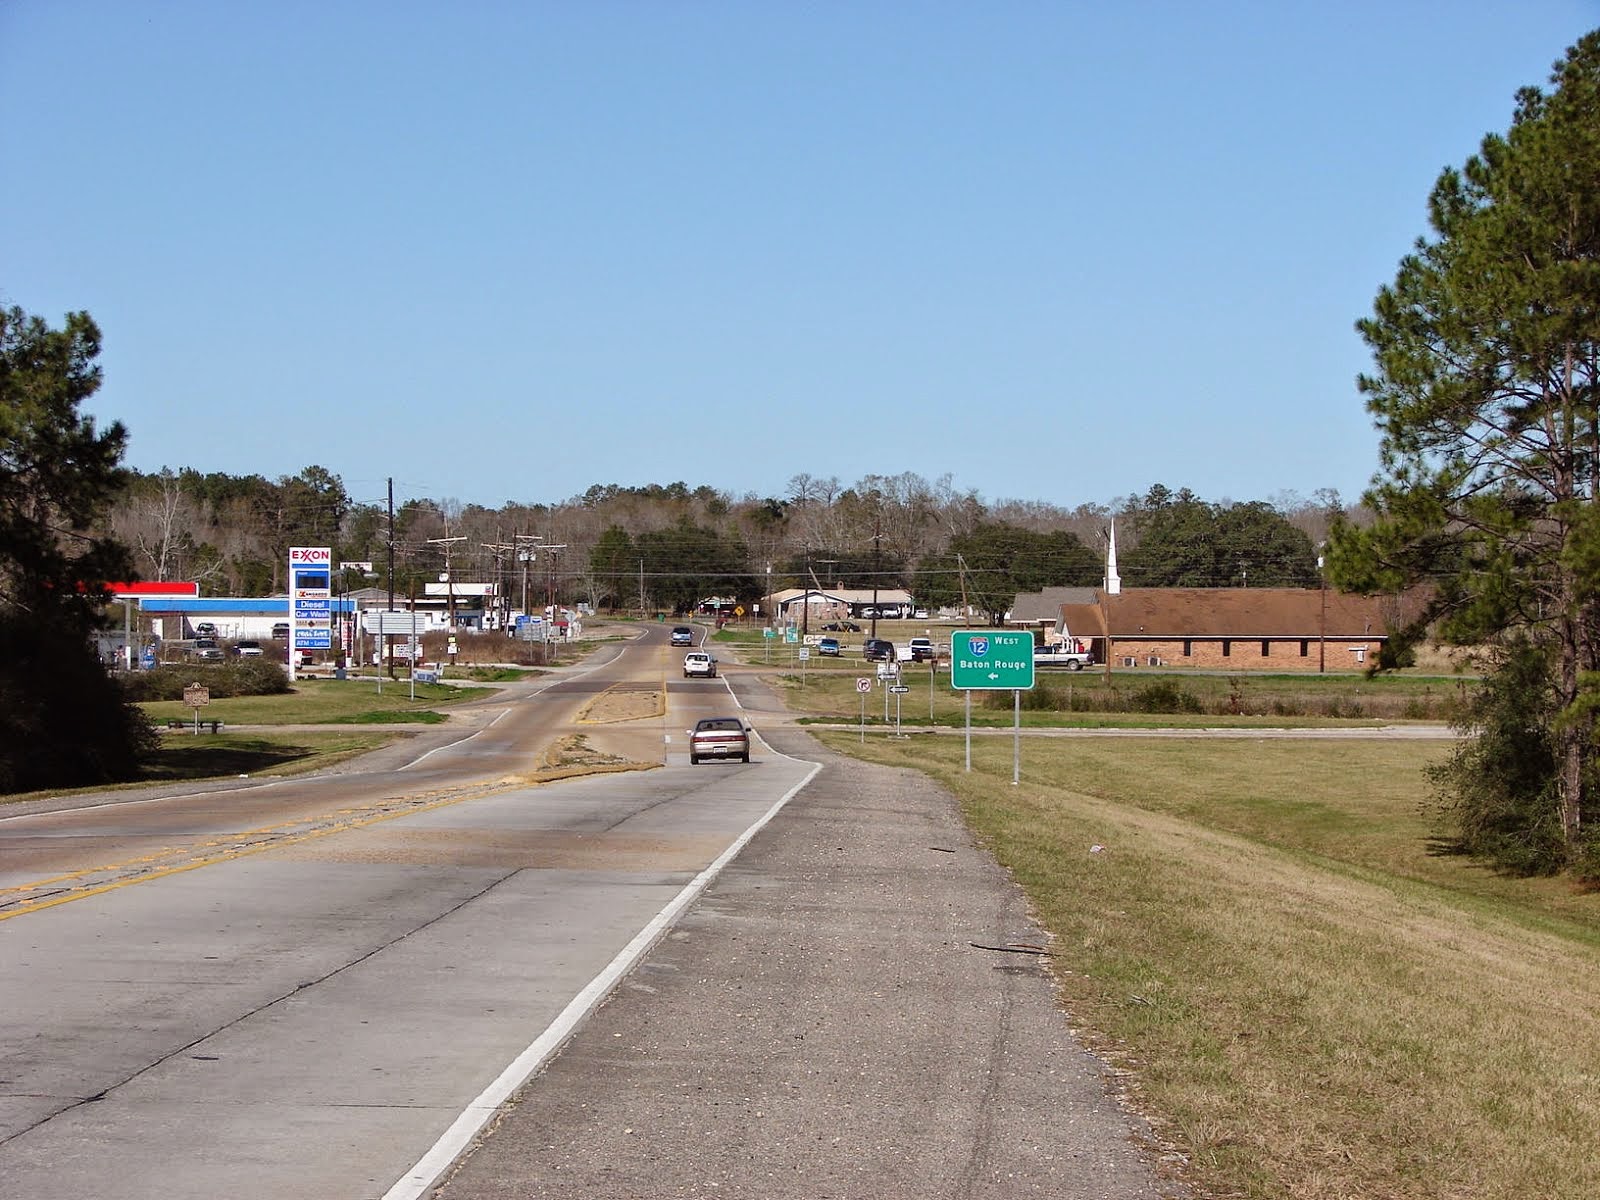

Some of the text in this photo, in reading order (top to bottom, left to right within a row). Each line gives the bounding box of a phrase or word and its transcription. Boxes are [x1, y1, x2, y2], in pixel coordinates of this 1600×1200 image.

[292, 549, 329, 563] EXXON
[300, 600, 325, 608] Diesel
[296, 610, 330, 618] Car Wash
[972, 641, 985, 653] 12
[960, 660, 1026, 671] Baton Rouge
